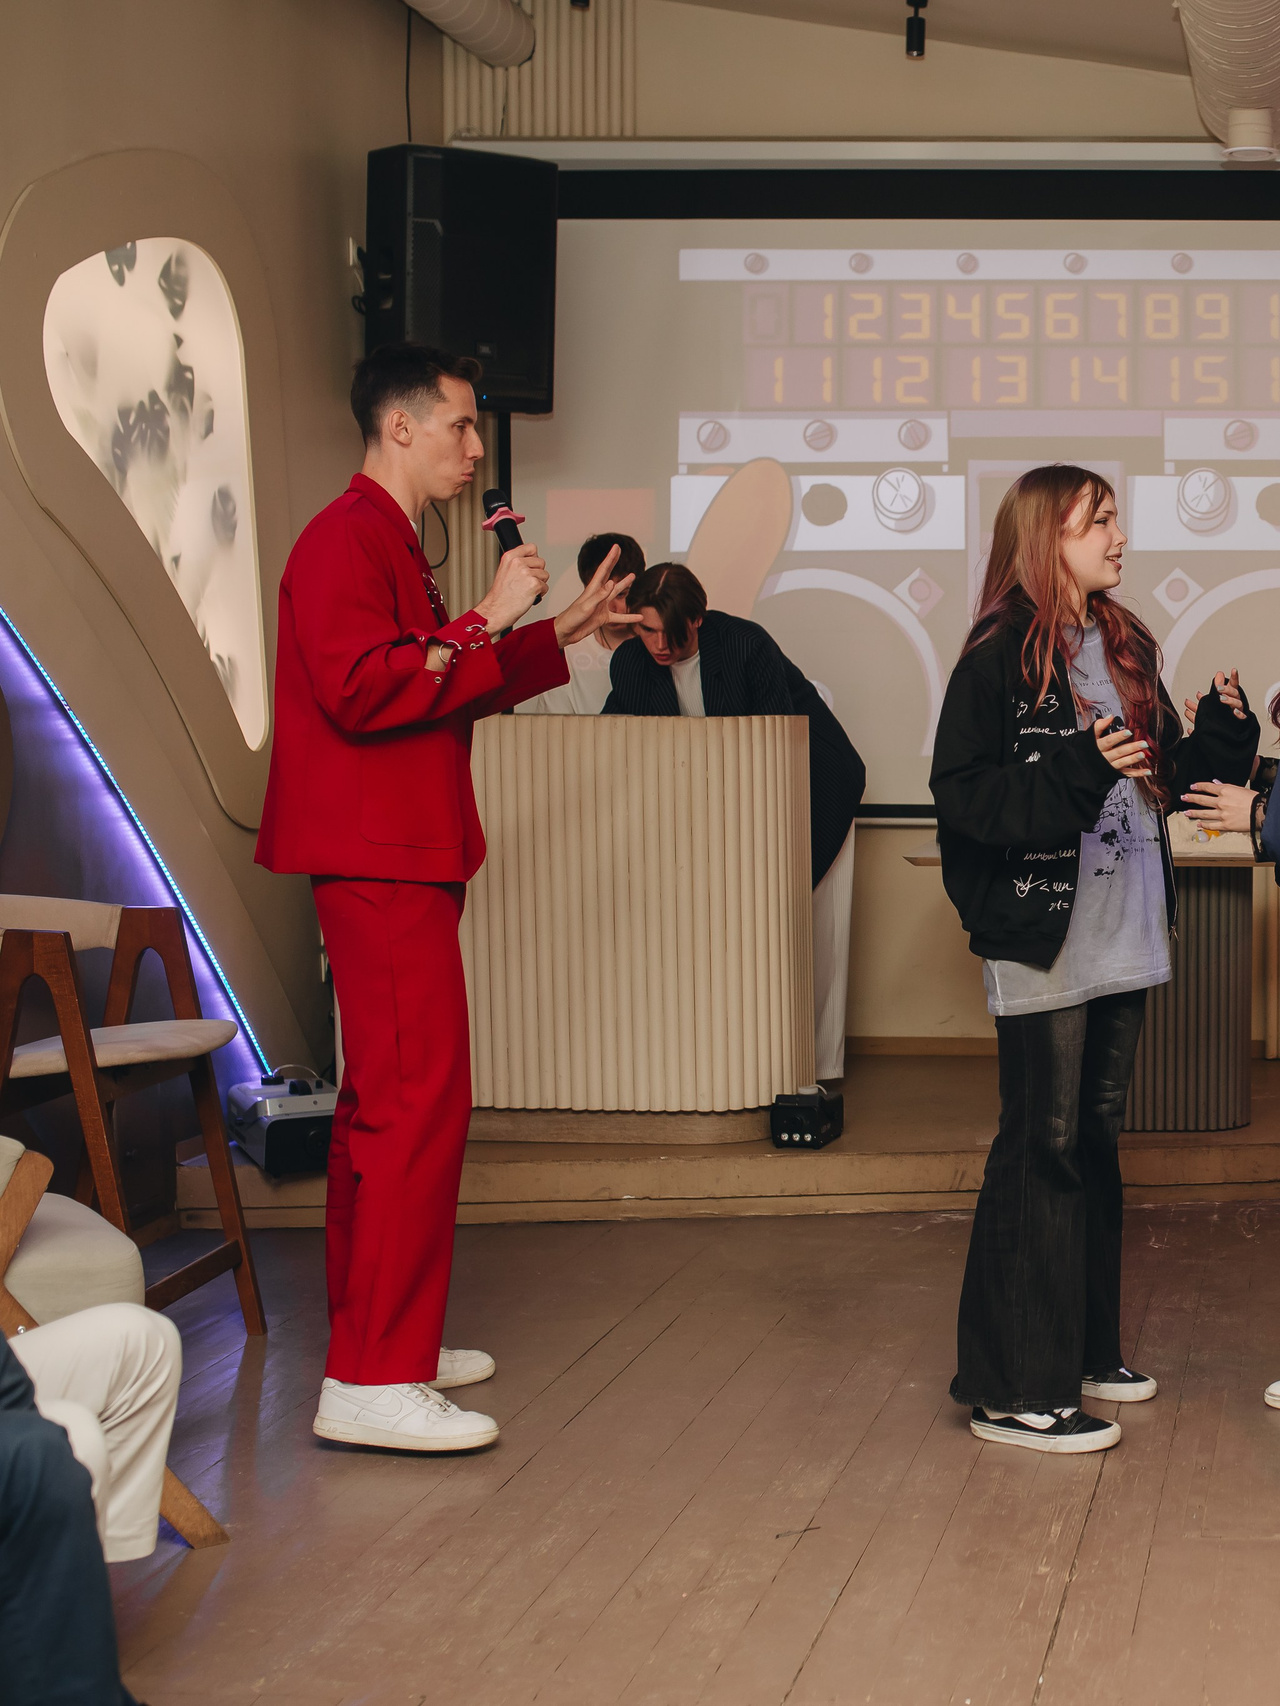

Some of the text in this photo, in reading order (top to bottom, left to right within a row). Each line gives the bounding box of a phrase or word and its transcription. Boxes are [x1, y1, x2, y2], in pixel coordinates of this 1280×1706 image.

[823, 293, 834, 340] 1
[849, 293, 883, 340] 2
[899, 293, 931, 340] 3
[947, 293, 981, 340] 4
[996, 293, 1030, 340] 5
[1045, 293, 1079, 340] 6
[1095, 293, 1127, 340] 7
[1145, 293, 1180, 340] 8
[1195, 293, 1230, 340] 9
[773, 355, 834, 404] 11
[872, 355, 930, 404] 12
[971, 355, 1028, 404] 13
[1069, 355, 1129, 404] 14
[1169, 355, 1229, 404] 15
